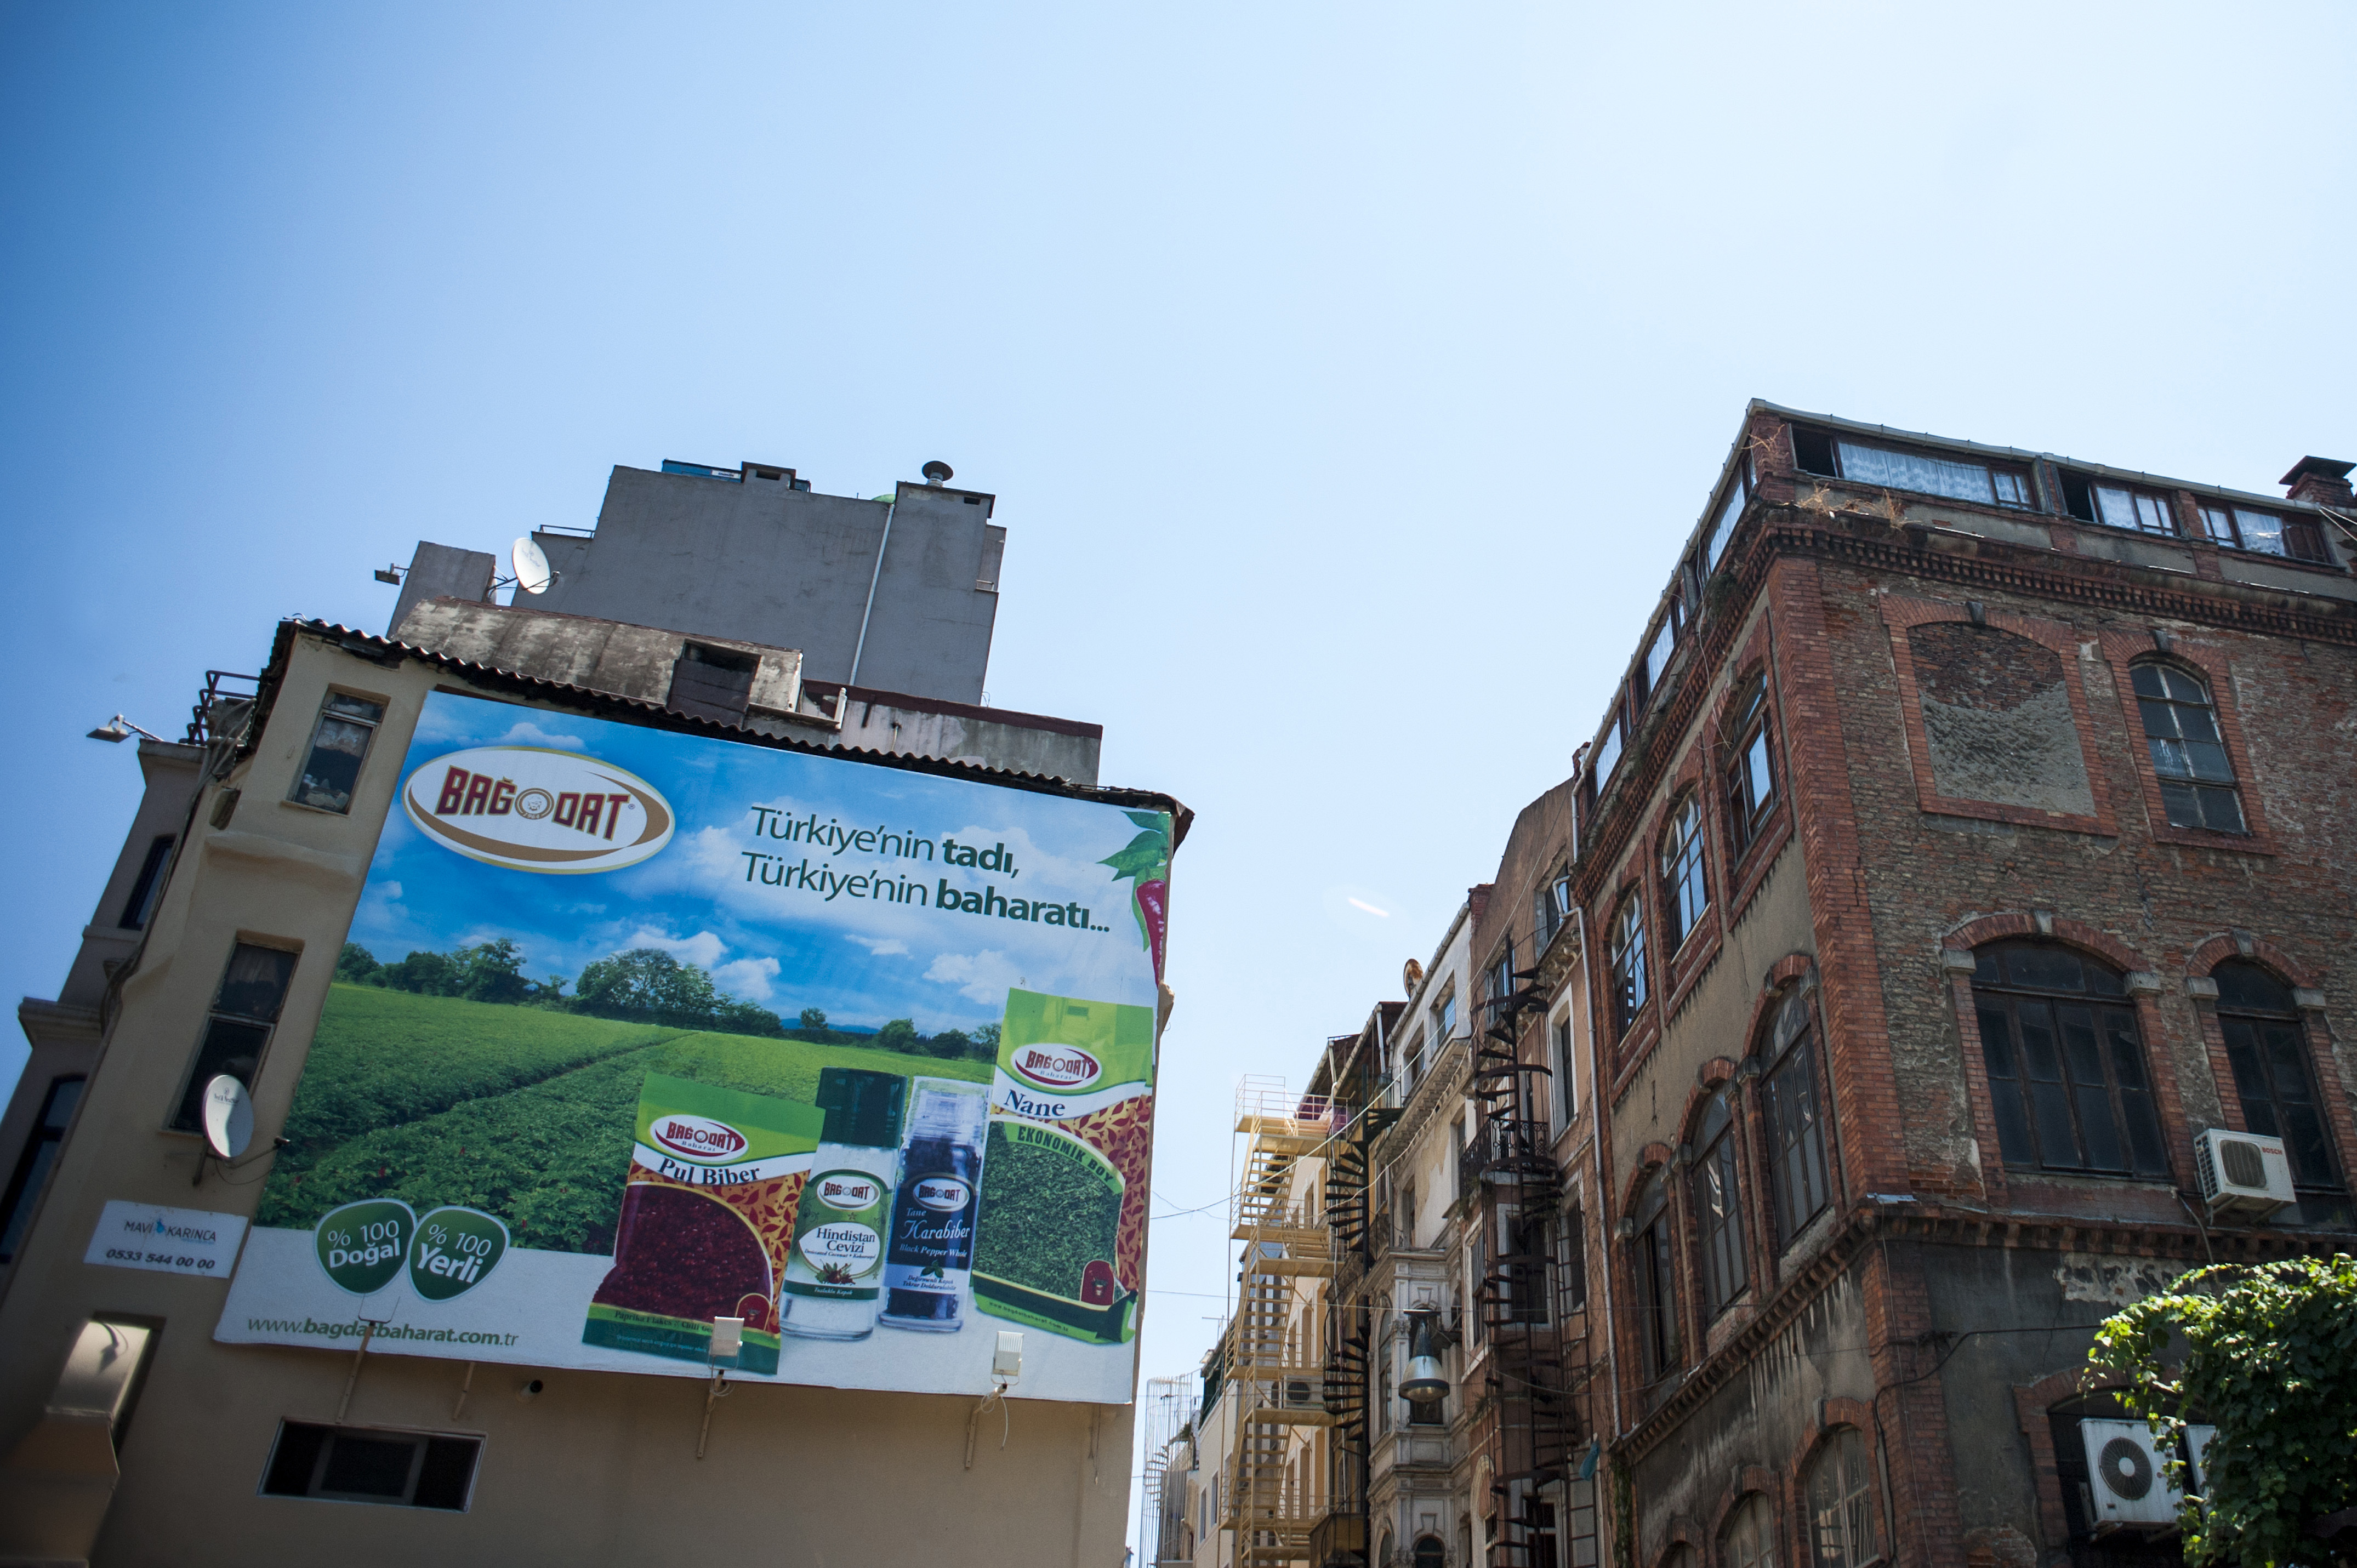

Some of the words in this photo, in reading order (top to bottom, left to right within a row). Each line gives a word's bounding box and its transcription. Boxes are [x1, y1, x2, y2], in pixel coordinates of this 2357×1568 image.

[751, 806, 934, 861] Türkiye'nin
[943, 839, 1020, 878] tadı,
[741, 851, 927, 906] Türkiye'nin
[937, 879, 1111, 932] baharatı...
[1040, 1070, 1072, 1080] Baharat
[1004, 1089, 1066, 1116] Nane
[682, 1141, 716, 1151] Baharat
[1017, 1126, 1086, 1162] EKONOMİK
[1088, 1158, 1114, 1182] BOY
[2262, 1147, 2282, 1155] BOSCH
[658, 1157, 695, 1182] Pul
[702, 1167, 760, 1185] Biber
[906, 1207, 927, 1217] Tane
[167, 1226, 216, 1241] KARINCA
[328, 1229, 351, 1248] %
[360, 1219, 399, 1243] 100
[817, 1228, 875, 1242] Hindistan
[899, 1219, 970, 1239] Karabiber
[428, 1224, 447, 1245] %
[454, 1232, 492, 1257] 100
[827, 1240, 864, 1253] Cevizi
[899, 1243, 920, 1253] Black
[920, 1246, 948, 1257] Pepper
[106, 1249, 143, 1261] 0533
[145, 1253, 173, 1264] 544
[176, 1257, 194, 1267] 00
[197, 1259, 215, 1269] 00
[329, 1238, 401, 1269] Doğal
[417, 1243, 483, 1284] Yerli
[615, 1310, 645, 1322] Paprika
[647, 1316, 672, 1326] Flakes
